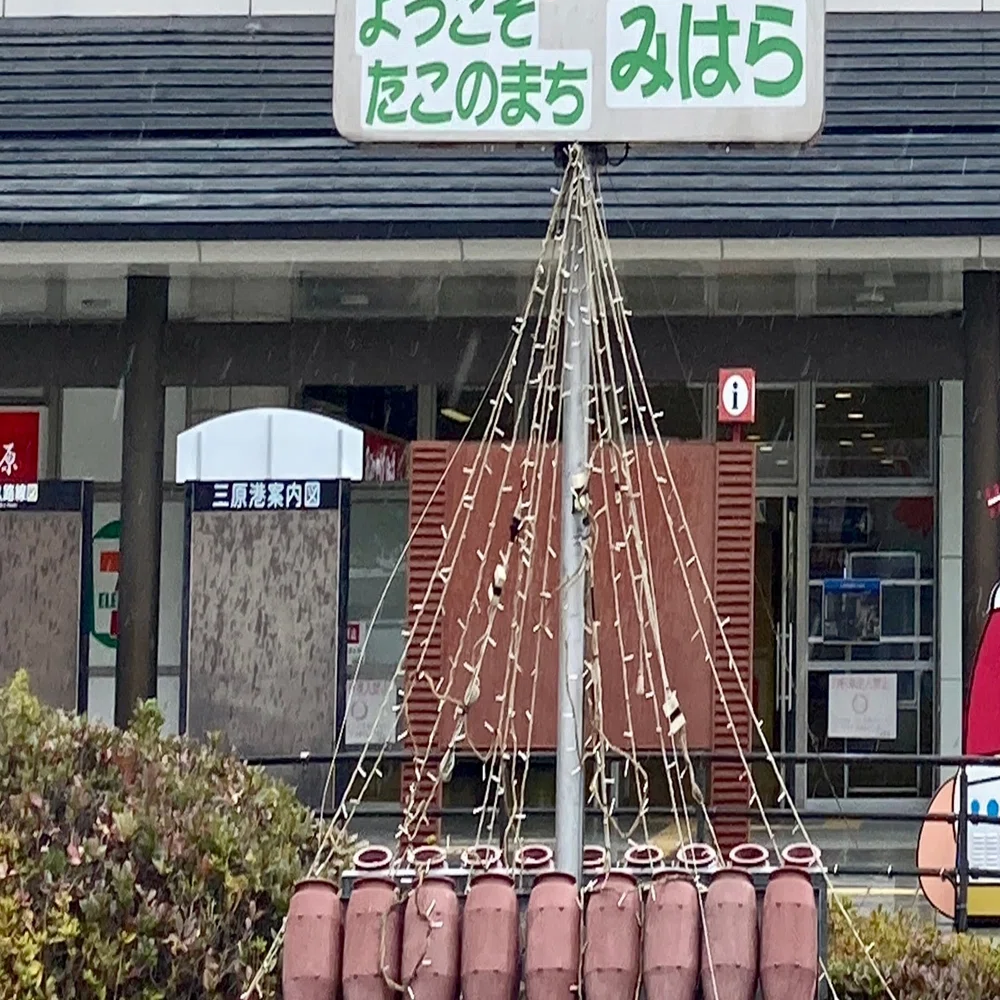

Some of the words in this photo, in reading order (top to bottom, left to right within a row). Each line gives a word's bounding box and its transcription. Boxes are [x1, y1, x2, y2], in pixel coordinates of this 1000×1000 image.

[610, 3, 804, 101] みはら
[365, 59, 588, 127] たこのまち
[212, 481, 321, 509] 三原港案内図
